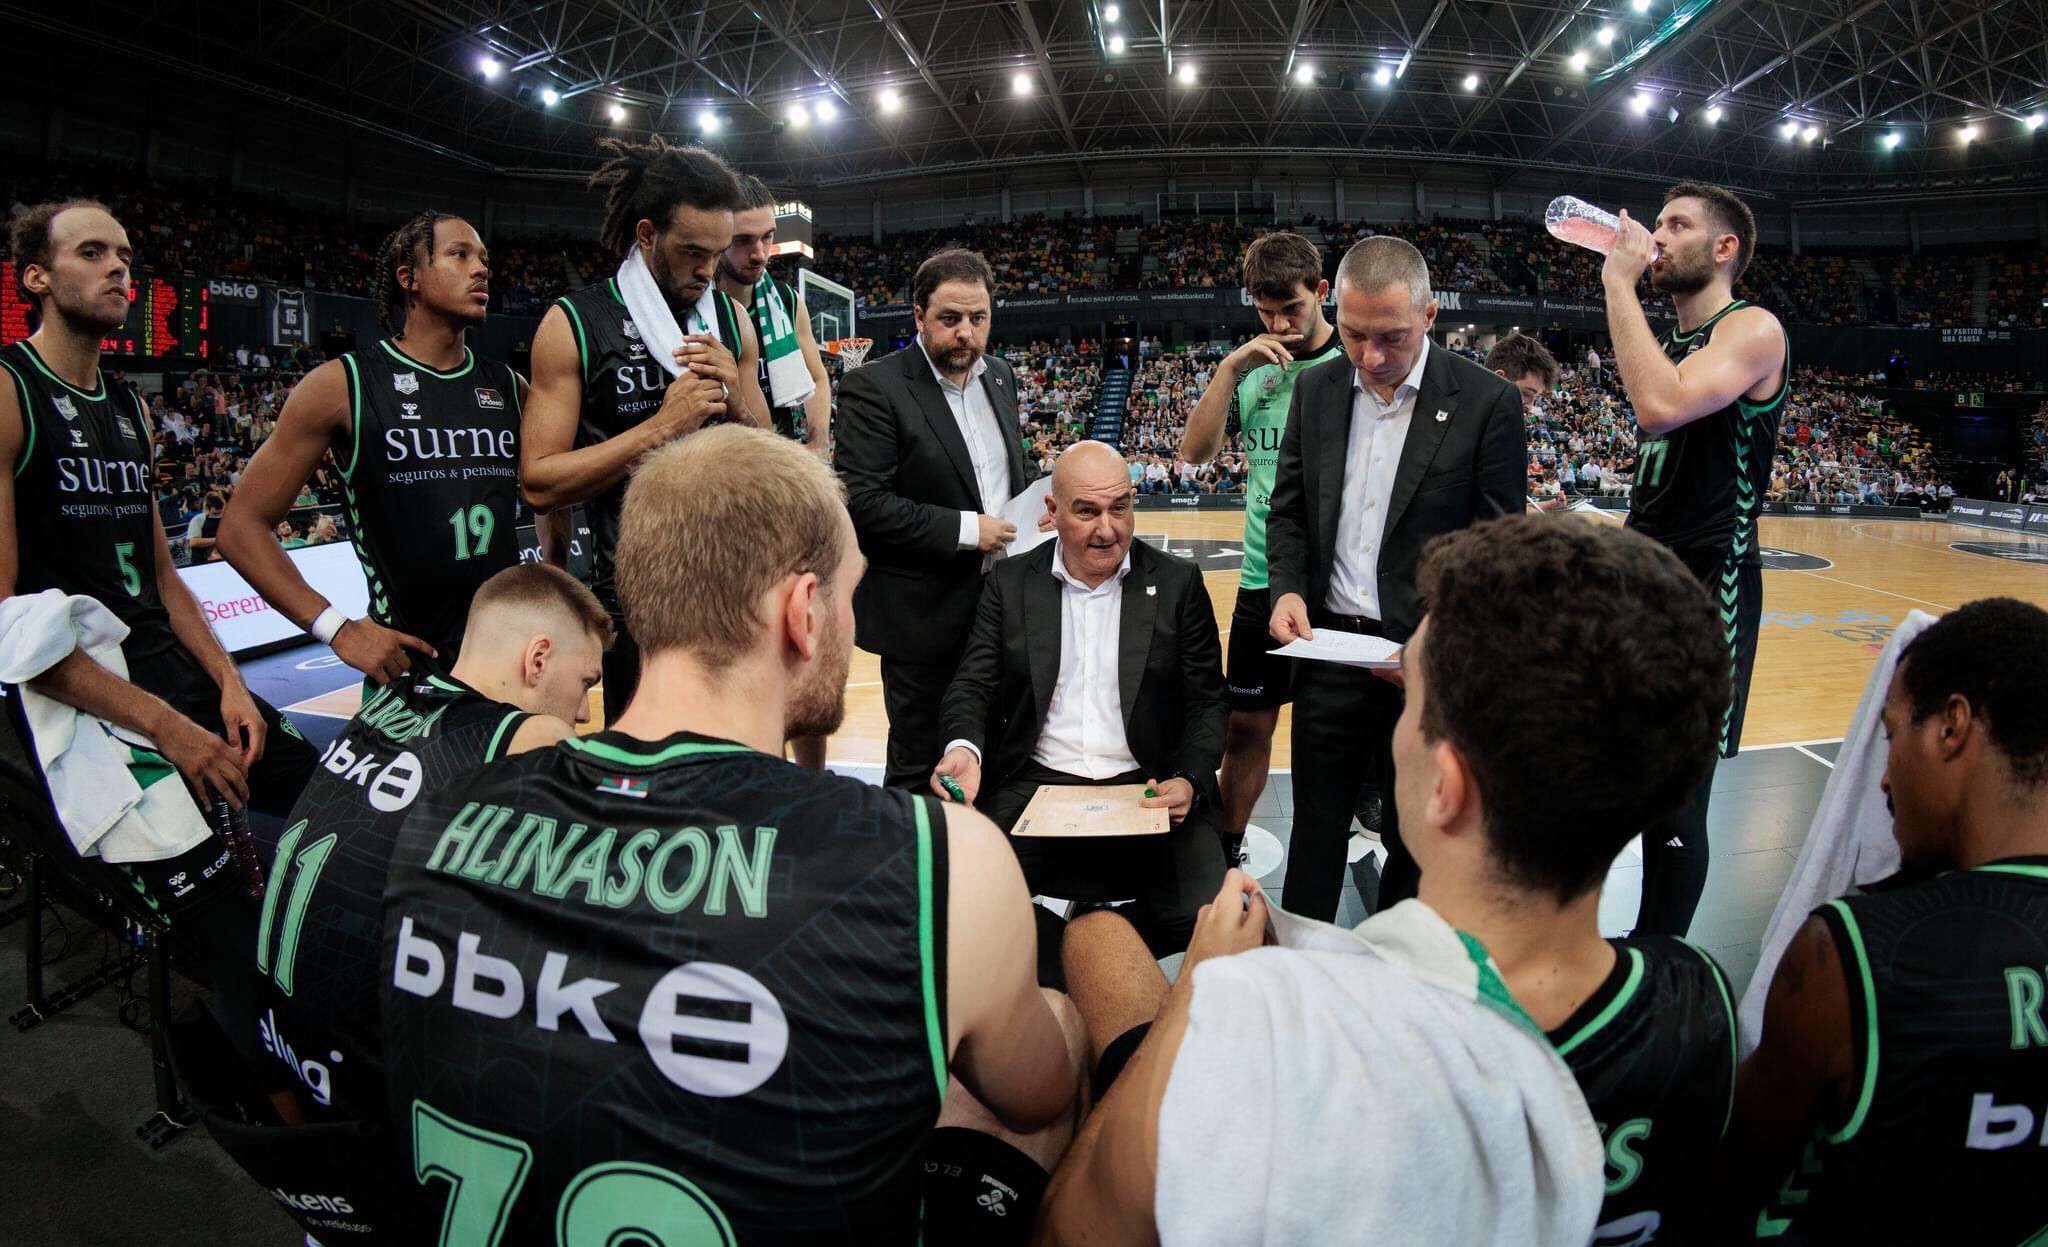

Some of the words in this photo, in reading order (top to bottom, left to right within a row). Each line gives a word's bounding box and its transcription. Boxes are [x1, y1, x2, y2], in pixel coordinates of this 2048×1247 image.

[285, 308, 298, 325] 15
[1958, 394, 1966, 404] B
[384, 427, 516, 462] surne
[57, 456, 151, 494] surne
[388, 468, 447, 485] seguros
[449, 469, 459, 479] &
[462, 464, 516, 480] pensiones
[449, 503, 495, 561] 19
[114, 542, 142, 598] 5
[425, 800, 778, 919] HLINASON
[256, 817, 338, 998] 11
[393, 916, 621, 1045] bbk
[2003, 966, 2048, 1051] R
